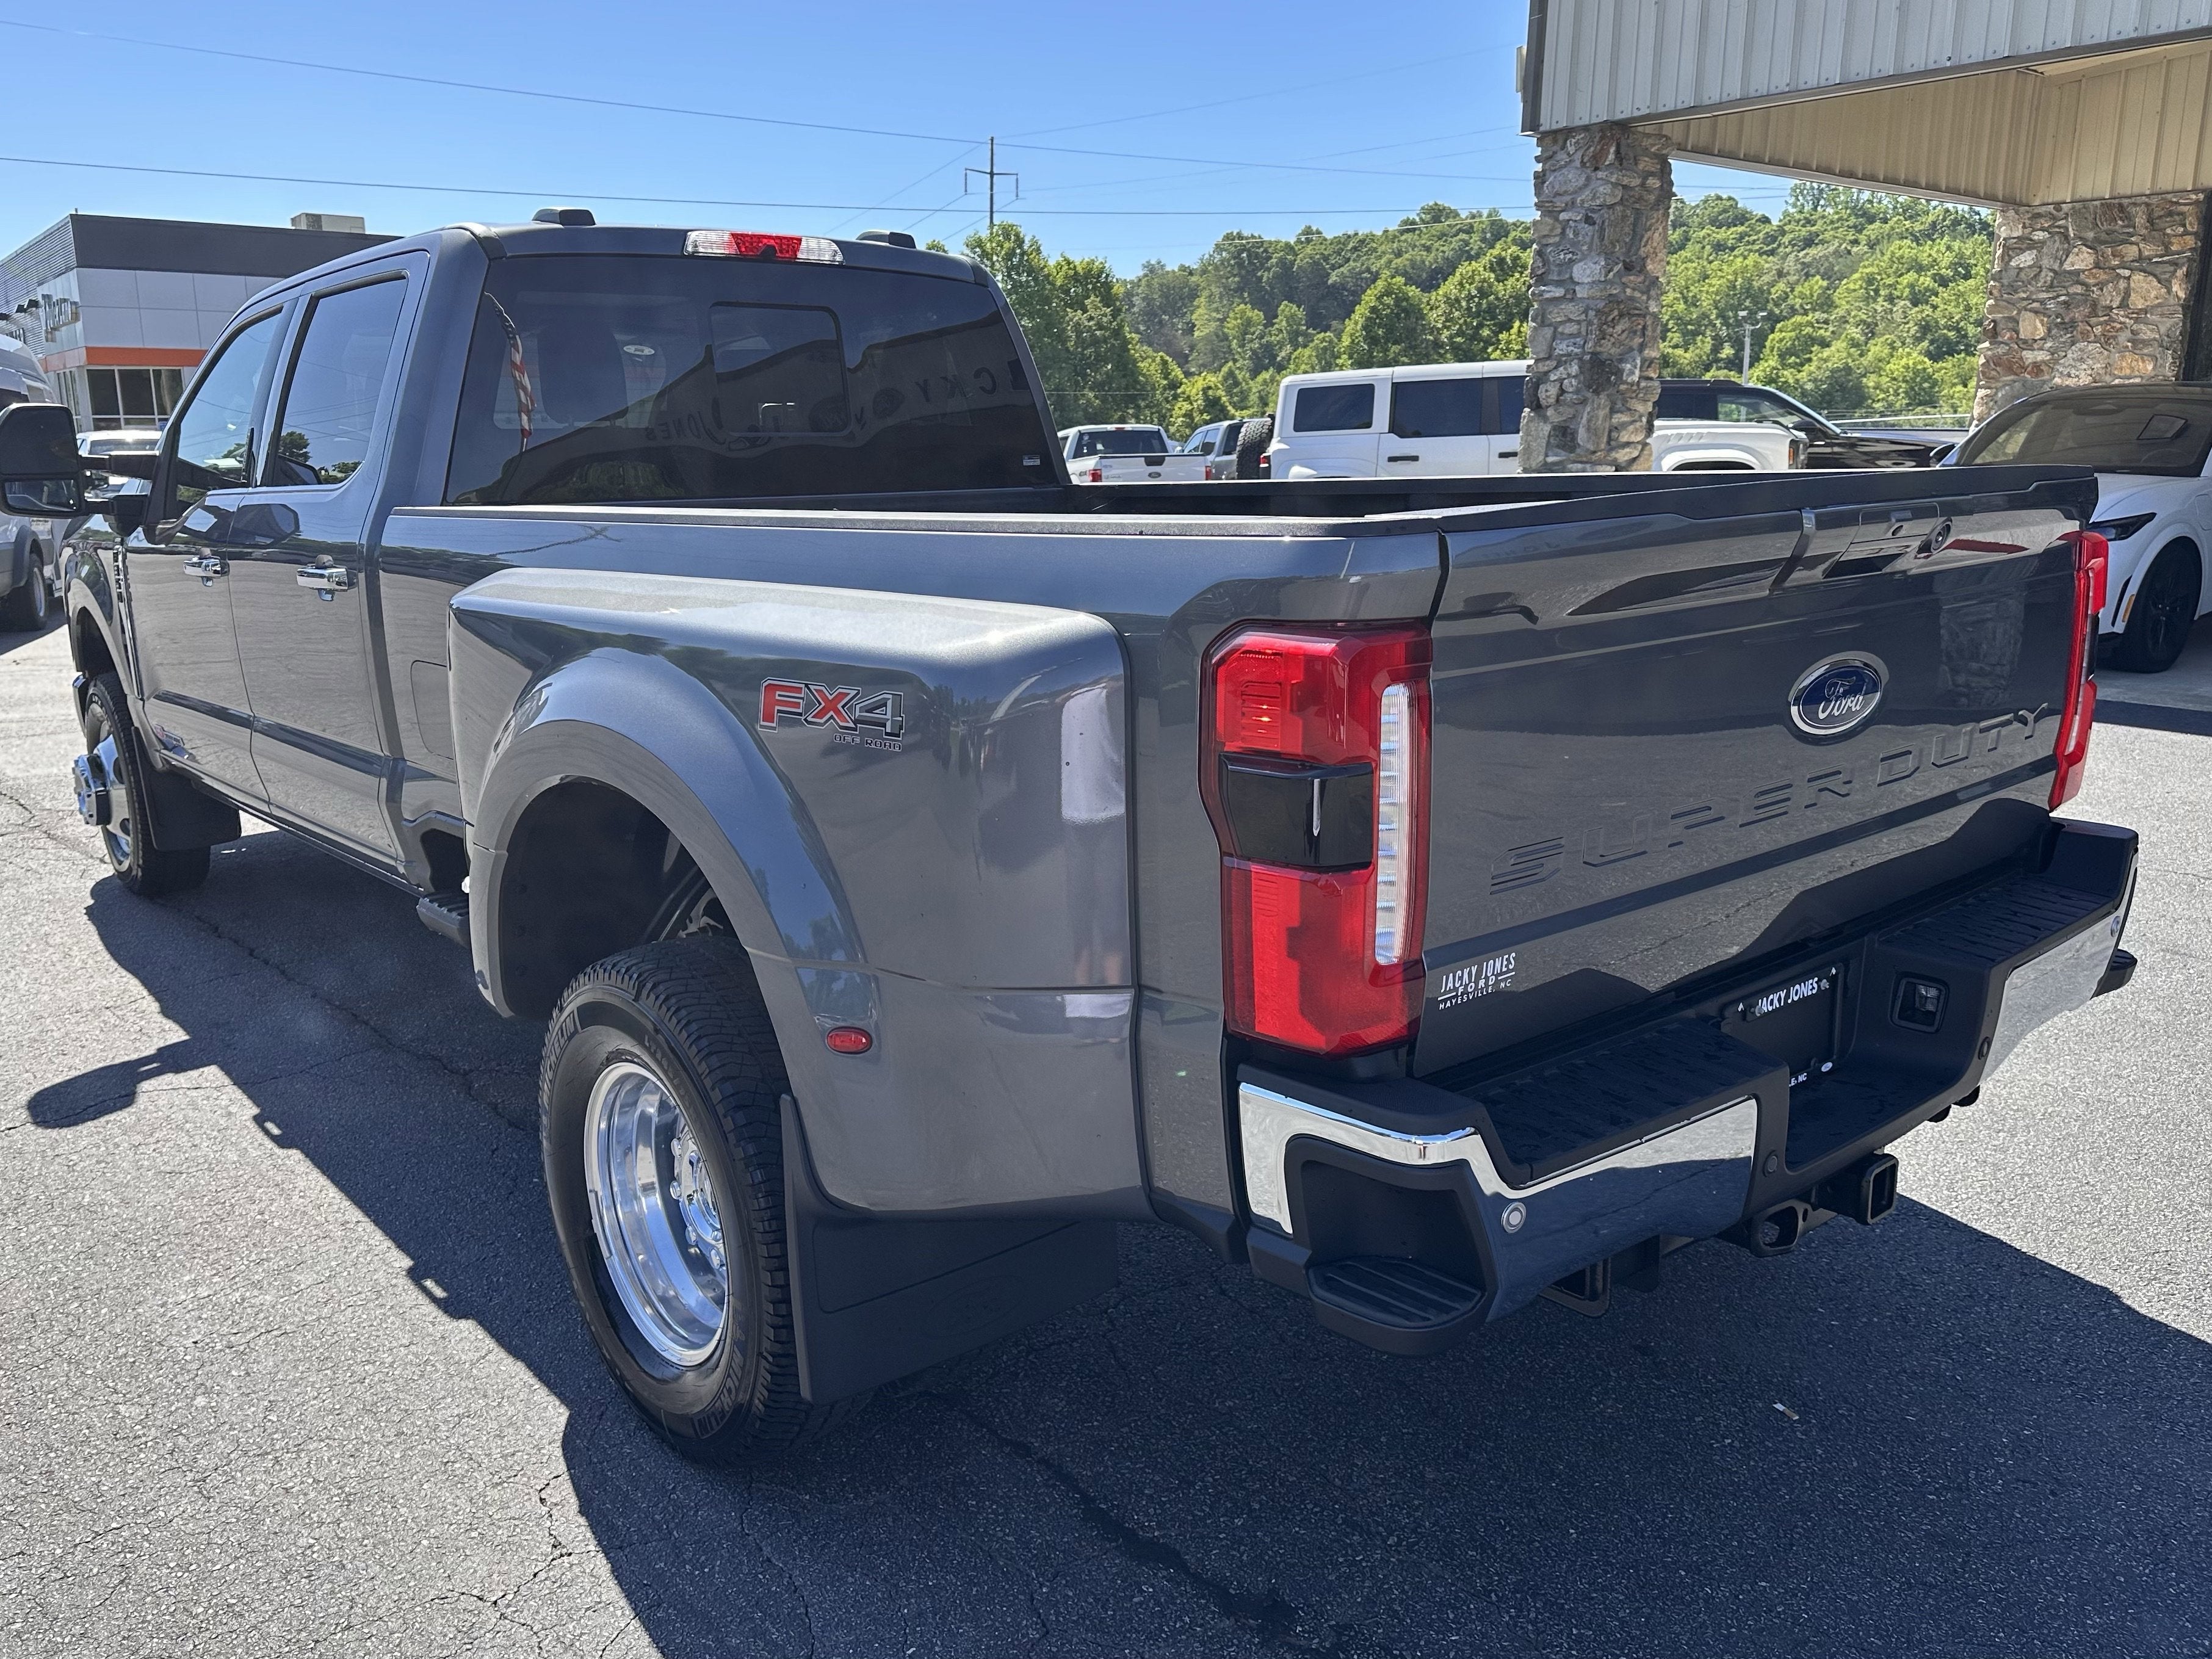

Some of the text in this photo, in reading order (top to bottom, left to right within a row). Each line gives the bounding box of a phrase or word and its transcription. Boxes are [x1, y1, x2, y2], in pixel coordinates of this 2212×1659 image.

[758, 677, 905, 739] FX4
[1818, 676, 1867, 720] Ford
[834, 734, 902, 752] OFF ROAD
[1489, 703, 2048, 895] SUPER DUTY
[1440, 952, 1516, 993] JACKY JONES
[1458, 975, 1495, 996] FORD
[1787, 977, 1819, 1004] JONES
[1439, 978, 1512, 1011] HAYESVILLE, NC
[542, 1011, 575, 1111] MICHELIN
[1798, 1072, 1807, 1083] NC
[696, 1343, 744, 1439] MICHELIN
